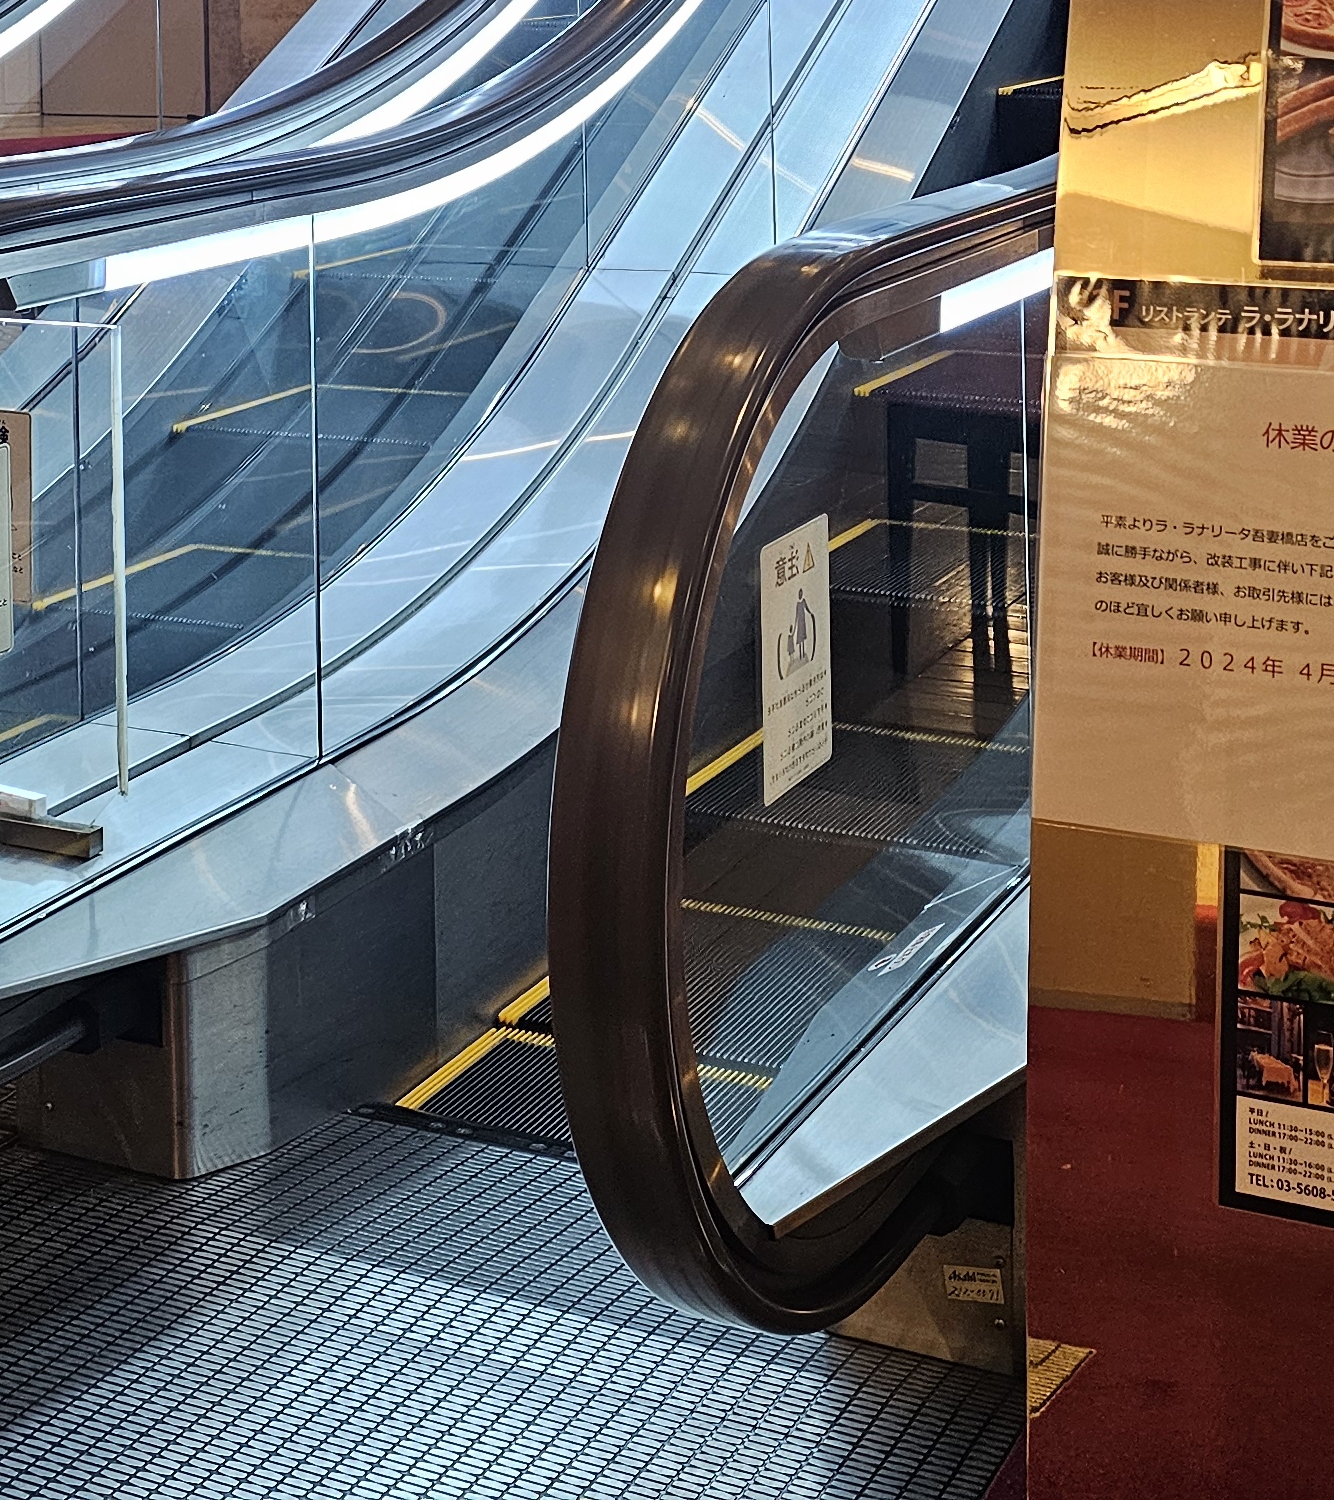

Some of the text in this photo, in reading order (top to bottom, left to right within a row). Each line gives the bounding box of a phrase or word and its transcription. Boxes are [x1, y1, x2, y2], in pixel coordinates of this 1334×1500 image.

[1142, 306, 1232, 326] リストランテ
[1248, 1118, 1275, 1129] LUNCH
[1249, 1127, 1276, 1138] DINNER
[1248, 1151, 1275, 1161] LUNCH
[1248, 1160, 1275, 1171] DINNER
